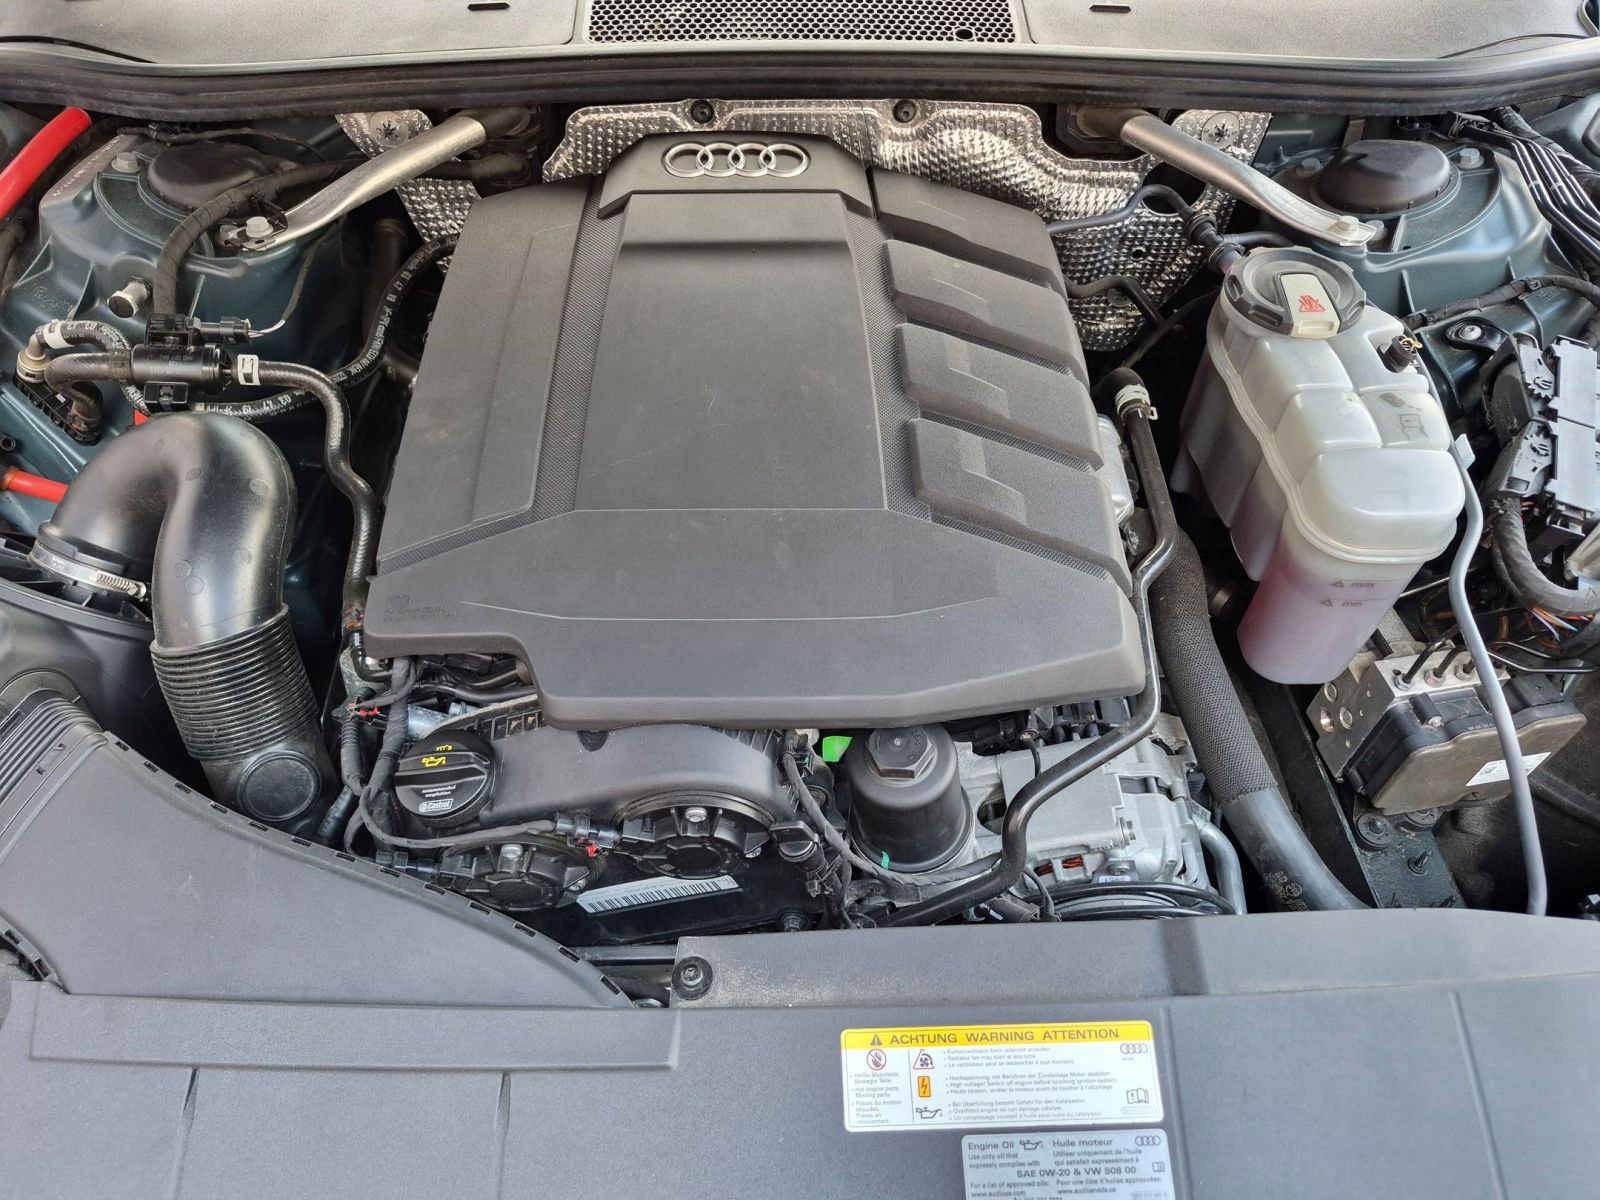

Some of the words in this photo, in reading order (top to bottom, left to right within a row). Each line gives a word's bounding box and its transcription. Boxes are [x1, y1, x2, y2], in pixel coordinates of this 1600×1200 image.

[428, 800, 450, 810] Castrol
[890, 1033, 958, 1045] ACHTUNG
[965, 1030, 1034, 1042] WARNING
[1042, 1028, 1120, 1040] ATTENTION
[968, 1142, 999, 1151] Engine
[1002, 1140, 1014, 1150] Oil
[1052, 1138, 1076, 1148] Huile
[1078, 1138, 1112, 1146] moteur
[998, 1160, 1026, 1168] complies
[1016, 1170, 1036, 1178] SAE
[1040, 1168, 1070, 1177] 0W-20
[1073, 1168, 1081, 1176] &
[1084, 1167, 1102, 1175] VW
[1104, 1166, 1122, 1175] 508
[1124, 1166, 1136, 1174] 00
